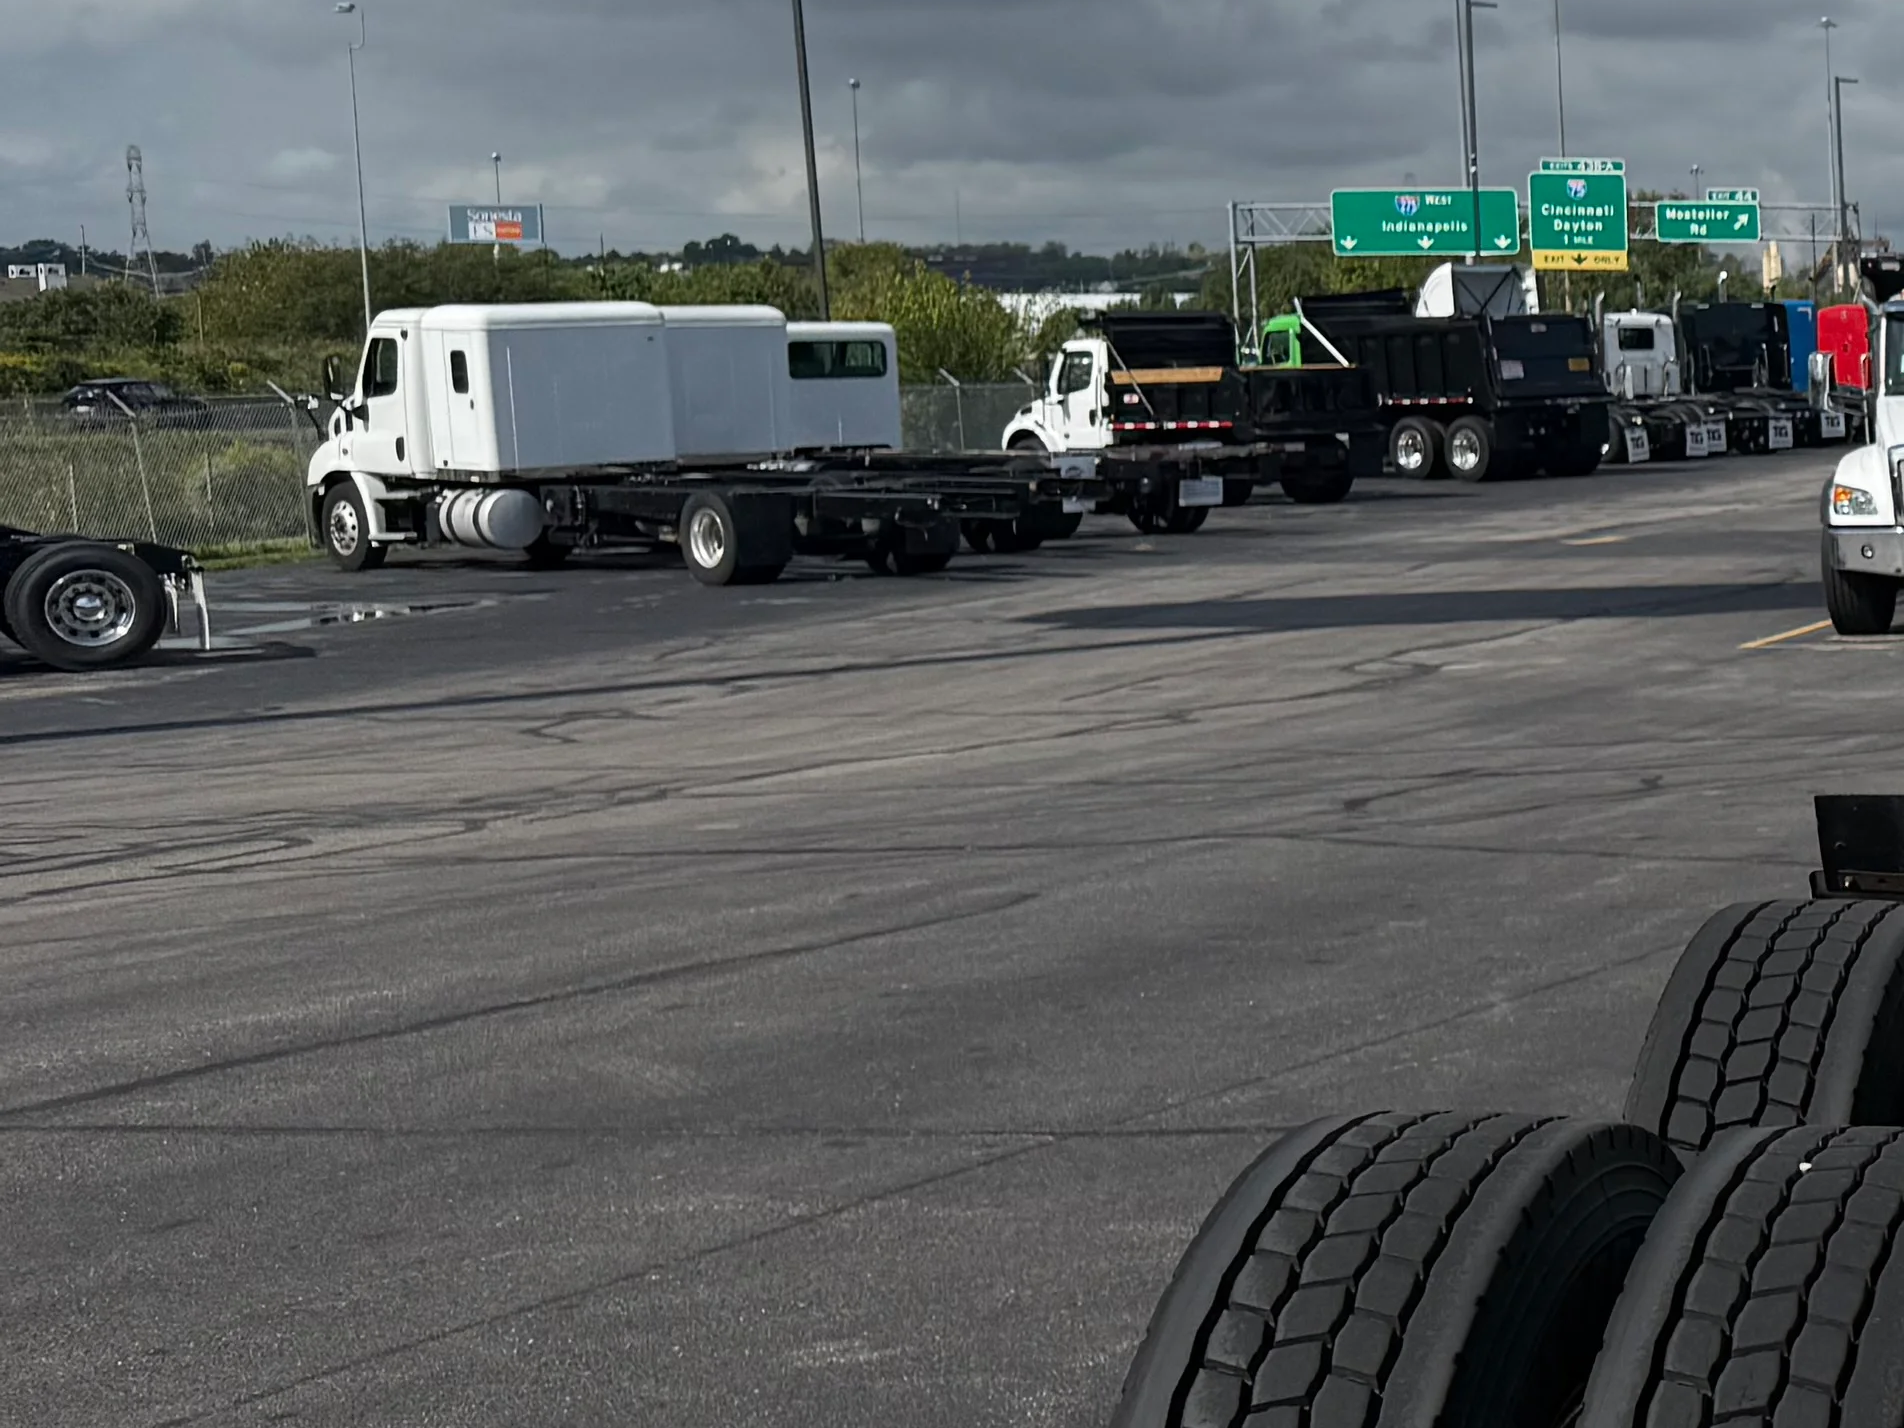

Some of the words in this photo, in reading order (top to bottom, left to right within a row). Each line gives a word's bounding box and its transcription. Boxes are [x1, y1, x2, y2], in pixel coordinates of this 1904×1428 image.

[1571, 185, 1586, 199] 75
[1541, 203, 1615, 217] Cincinnati
[1382, 220, 1468, 233] Indianapolis
[1553, 218, 1603, 233] Dayton
[1690, 222, 1708, 236] Rd
[1564, 234, 1569, 245] 1
[1543, 255, 1564, 264] EXIT
[1594, 256, 1620, 265] ONLY
